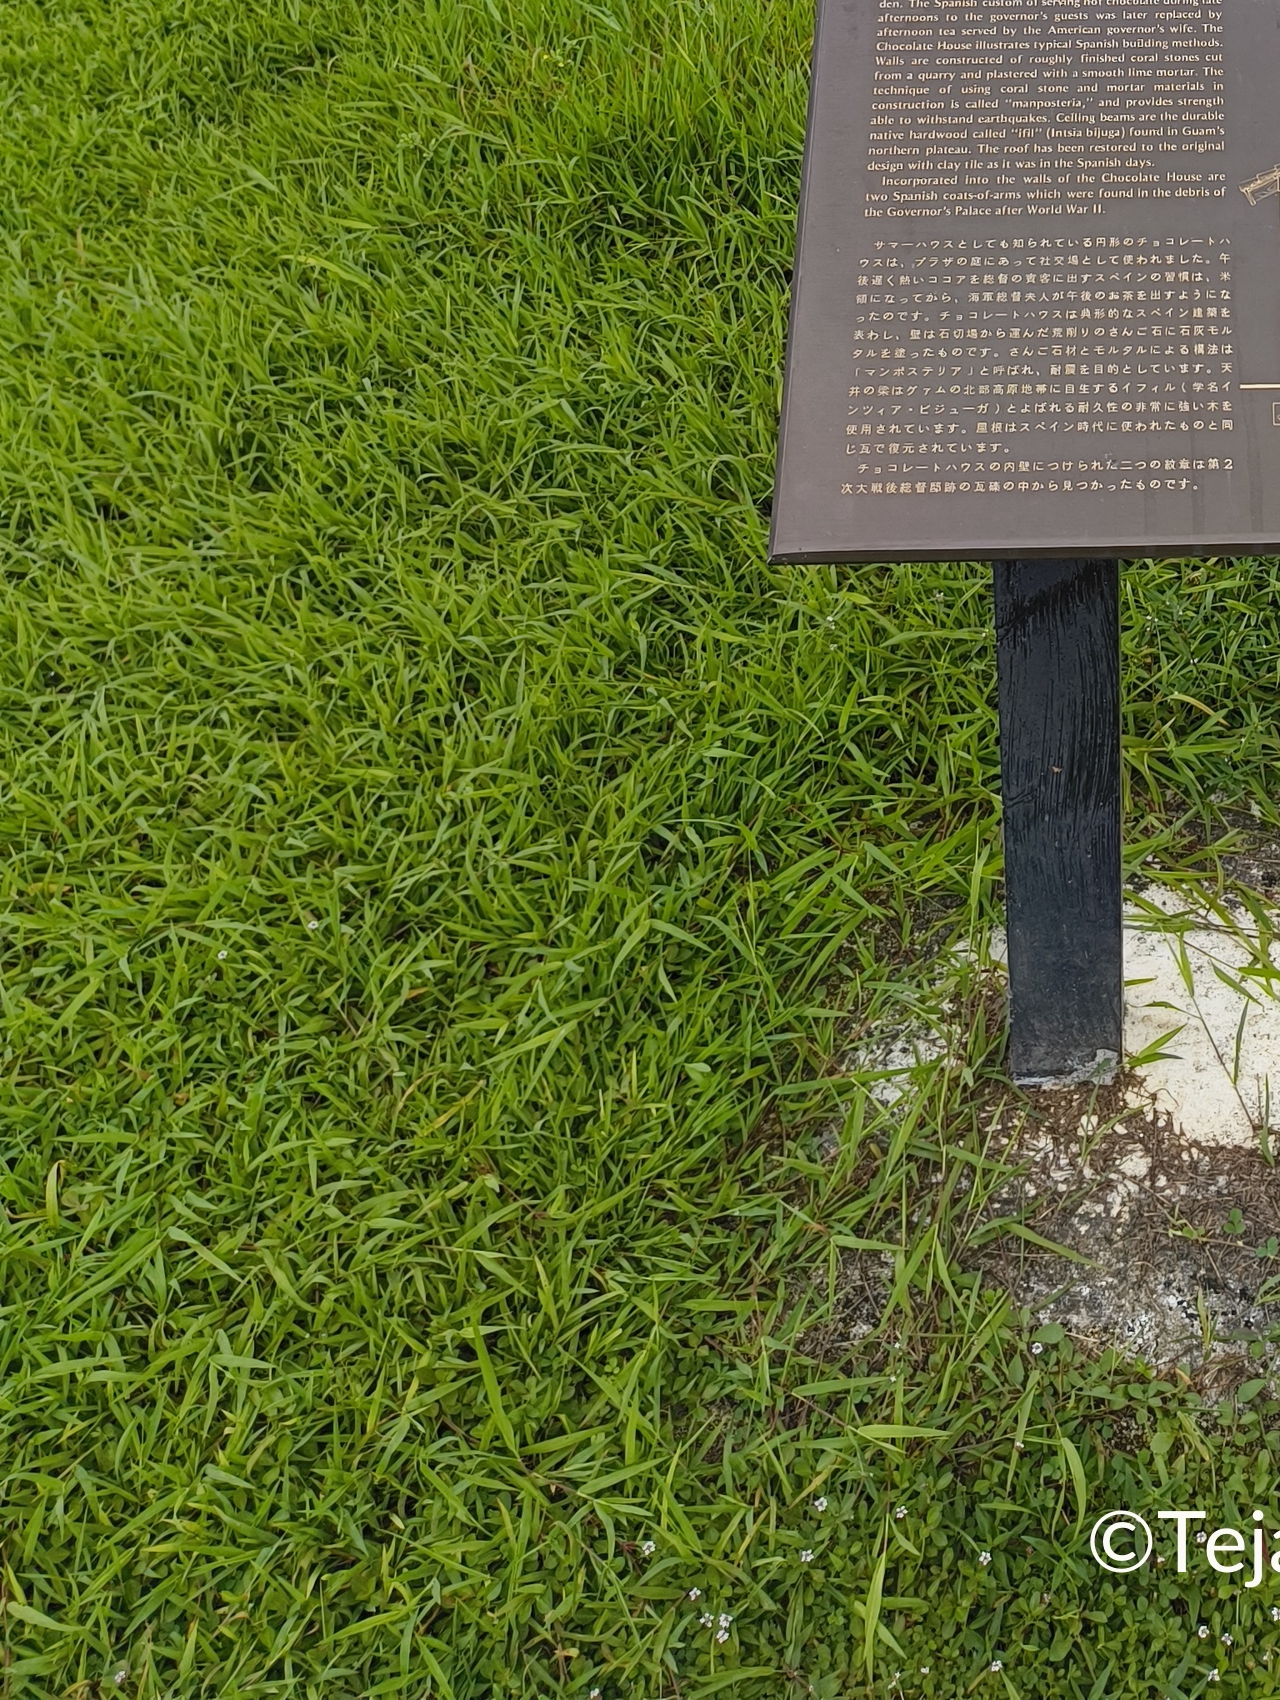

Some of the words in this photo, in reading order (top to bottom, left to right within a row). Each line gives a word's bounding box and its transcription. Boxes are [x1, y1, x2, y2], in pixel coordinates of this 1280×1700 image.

[878, 0, 903, 9] den.
[981, 0, 1023, 7] custom
[877, 12, 939, 23] afternoons
[945, 13, 958, 22] to
[964, 12, 984, 22] the
[1053, 12, 1089, 23] guests
[1095, 12, 1117, 20] was
[1122, 10, 1148, 20] later
[1208, 9, 1223, 21] by
[876, 27, 933, 37] afternoon
[938, 28, 956, 36] tea
[961, 25, 997, 36] served
[1002, 25, 1017, 37] by
[1023, 25, 1042, 35] the
[1047, 24, 1101, 35] American
[1200, 23, 1223, 33] The
[876, 41, 934, 51] Chocolate
[937, 40, 973, 51] House
[975, 40, 1031, 50] illustrates
[1033, 39, 1072, 52] typical
[1075, 38, 1119, 51] Spanish
[1171, 37, 1224, 48] methods.
[875, 55, 905, 66] Walls
[935, 54, 1003, 65] constructed
[1010, 54, 1024, 64] of
[1029, 54, 1073, 66] roughly
[1080, 52, 1125, 63] finished
[1130, 52, 1158, 63] coral
[1164, 53, 1200, 62] stones
[1205, 53, 1223, 62] cut
[874, 70, 902, 81] from
[906, 72, 913, 80] a
[917, 72, 956, 82] quarry
[960, 69, 982, 79] and
[986, 68, 1038, 81] plastered
[1042, 68, 1068, 78] with
[1072, 70, 1079, 78] a
[1081, 67, 1125, 78] smooth
[1128, 67, 1153, 77] lime
[1202, 66, 1224, 77] The
[873, 85, 930, 97] technique
[938, 84, 953, 94] of
[961, 84, 991, 96] using
[1000, 83, 1029, 94] coral
[1037, 85, 1069, 93] stone
[1077, 82, 1098, 93] and
[1106, 83, 1146, 92] mortar
[1153, 81, 1205, 92] materials
[1212, 81, 1224, 91] in
[871, 99, 945, 110] construction
[950, 99, 960, 109] is
[965, 98, 999, 109] called
[1098, 97, 1120, 107] and
[1177, 95, 1224, 108] strength
[870, 114, 895, 125] able
[899, 116, 912, 125] to
[916, 113, 974, 125] withstand
[977, 113, 1051, 125] earthquakes.
[1100, 112, 1136, 122] beams
[1138, 113, 1157, 122] are
[1160, 110, 1179, 122] the
[1181, 109, 1225, 121] durable
[869, 130, 905, 141] native
[909, 128, 968, 140] hardwood
[972, 128, 1006, 139] called
[1167, 126, 1178, 136] in
[868, 145, 920, 156] northern
[925, 144, 972, 157] plateau.
[976, 143, 1001, 154] The
[1003, 143, 1031, 154] roof
[1033, 143, 1053, 153] has
[1057, 142, 1085, 153] been
[1141, 143, 1154, 152] to
[1158, 141, 1178, 152] the
[907, 159, 933, 170] with
[937, 159, 961, 172] clay
[964, 159, 984, 169] tile
[986, 161, 999, 169] as
[1001, 158, 1011, 169] it
[1015, 160, 1037, 169] was
[1039, 158, 1051, 169] in
[1054, 157, 1074, 168] the
[1076, 157, 1121, 170] Spanish
[1125, 157, 1155, 169] days.
[965, 174, 989, 185] into
[996, 174, 1016, 185] the
[1022, 173, 1053, 184] walls
[1057, 173, 1071, 184] of
[1076, 172, 1096, 183] the
[1101, 171, 1160, 183] Chocolate
[1166, 171, 1202, 182] House
[1207, 173, 1226, 181] are
[865, 193, 888, 202] two
[892, 190, 938, 203] Spanish
[942, 189, 1022, 201] coats-of-arms
[1026, 188, 1061, 200] which
[1066, 190, 1094, 199] were
[1099, 187, 1134, 199] found
[1137, 187, 1149, 198] in
[1152, 187, 1172, 198] the
[1174, 186, 1210, 198] debris
[1213, 186, 1227, 197] of
[864, 206, 883, 217] the
[955, 205, 992, 216] Palace
[994, 204, 1024, 216] after
[1026, 204, 1062, 215] World
[1066, 203, 1089, 214] War
[1093, 203, 1106, 214] II.
